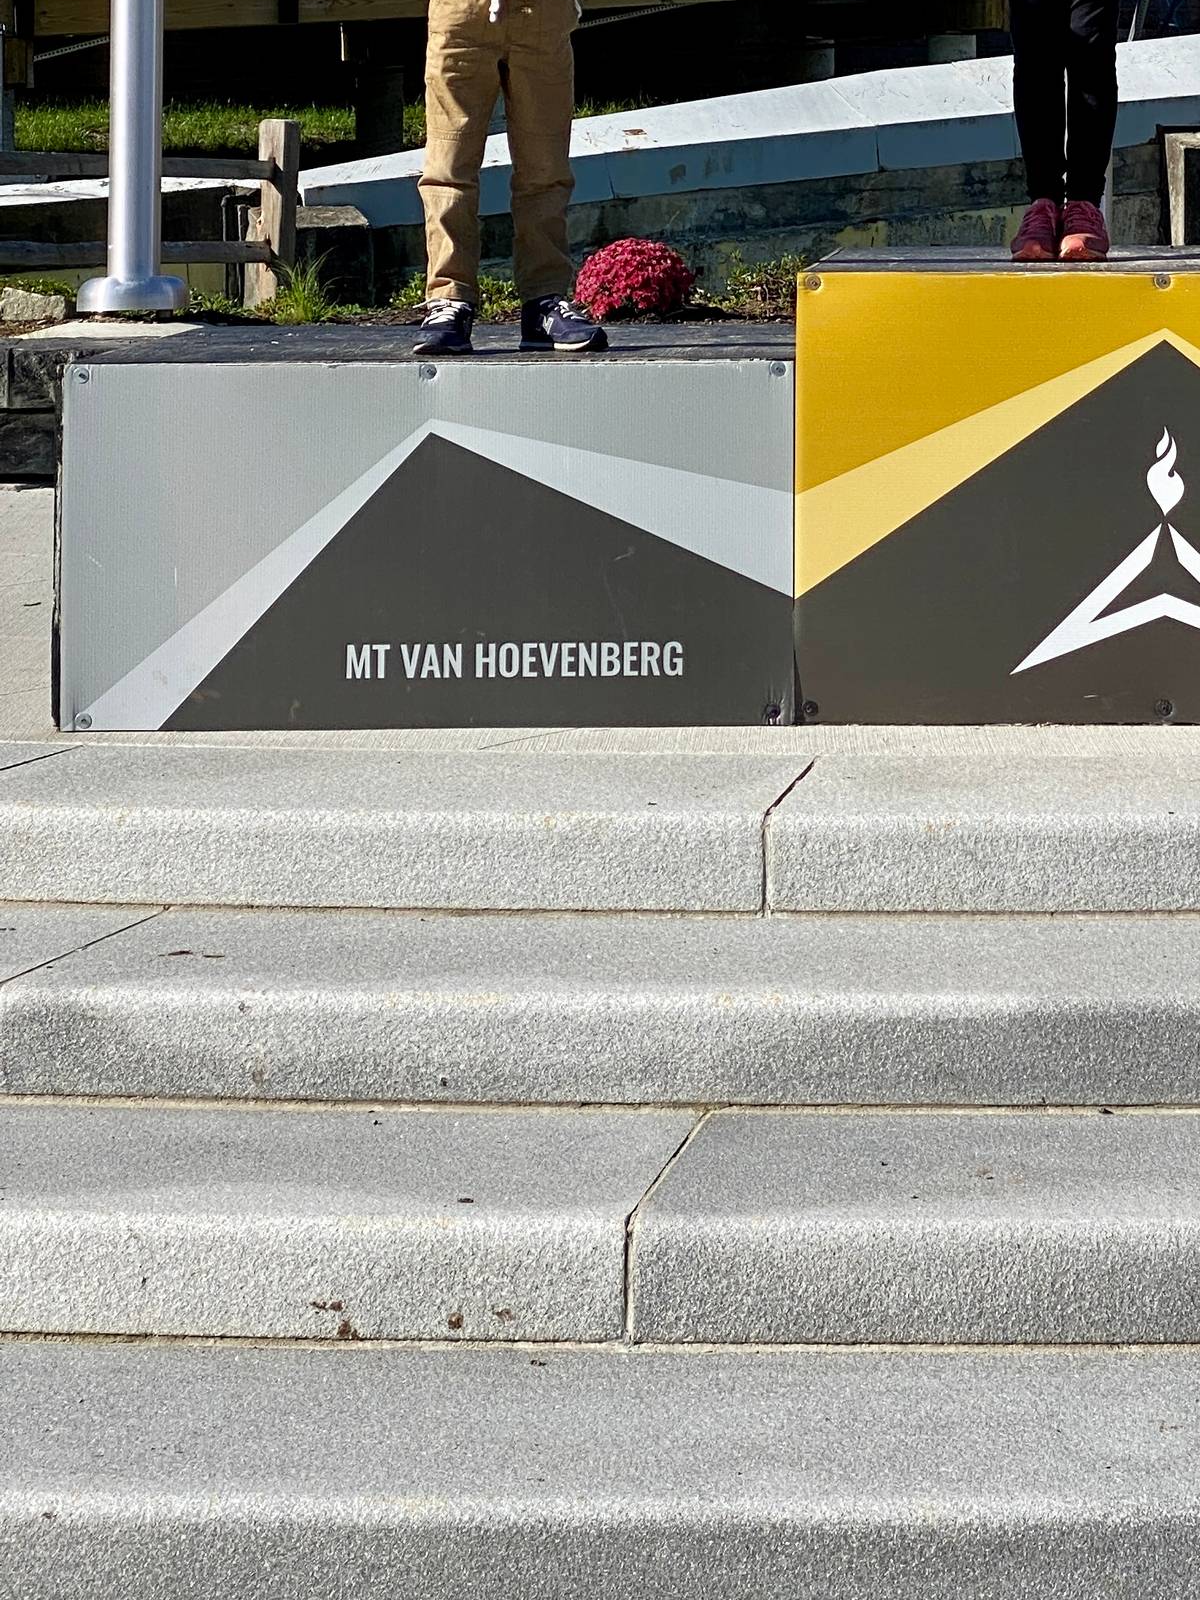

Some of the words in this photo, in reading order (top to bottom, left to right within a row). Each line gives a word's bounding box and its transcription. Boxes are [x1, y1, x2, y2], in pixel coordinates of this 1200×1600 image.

[345, 643, 391, 680] MT
[400, 643, 463, 679] VAN
[475, 641, 684, 678] HOEVENBERG
